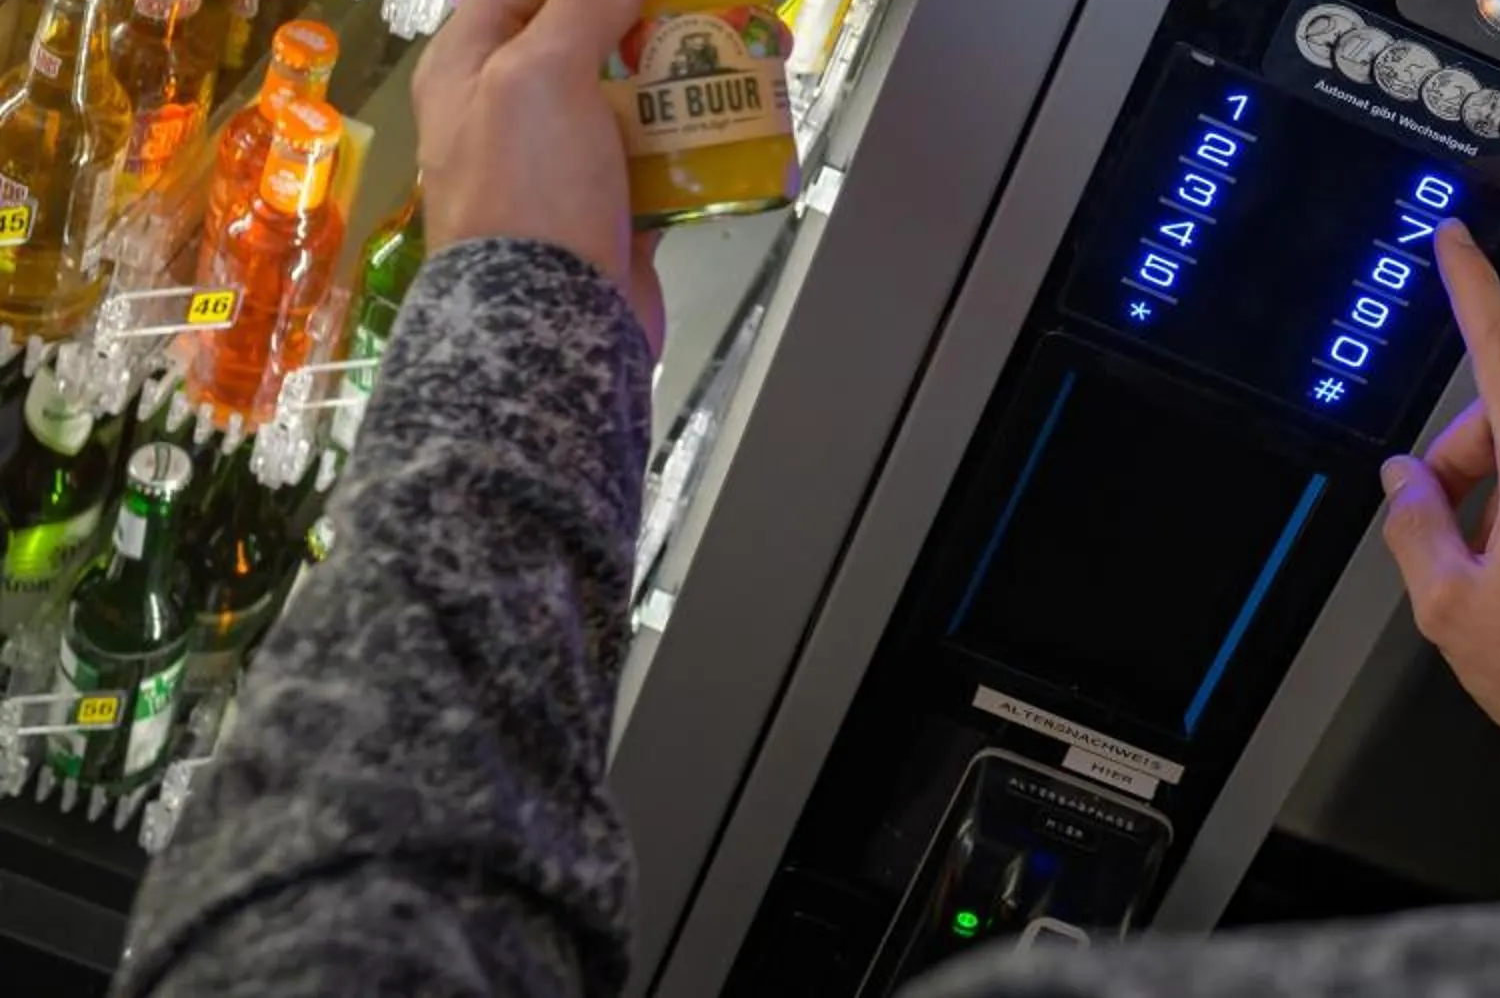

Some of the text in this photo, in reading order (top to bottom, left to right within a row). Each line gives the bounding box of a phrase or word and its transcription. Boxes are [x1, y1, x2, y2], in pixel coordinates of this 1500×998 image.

[637, 78, 763, 126] DE BUUR
[1227, 95, 1248, 121] 1
[1314, 79, 1479, 156] Automat gibt Wechselgeld
[1197, 133, 1236, 167] 2
[1178, 174, 1217, 208] 3
[1415, 176, 1454, 209] 6
[1160, 221, 1195, 247] 4
[1398, 215, 1436, 244] 7
[1141, 254, 1179, 288] 5
[1372, 258, 1411, 290] 8
[194, 297, 229, 316] 46
[1351, 298, 1389, 329] 9
[1331, 337, 1369, 368] 0
[1000, 700, 1163, 771] ALTERSNACHWEIS
[1090, 760, 1134, 786] HIER
